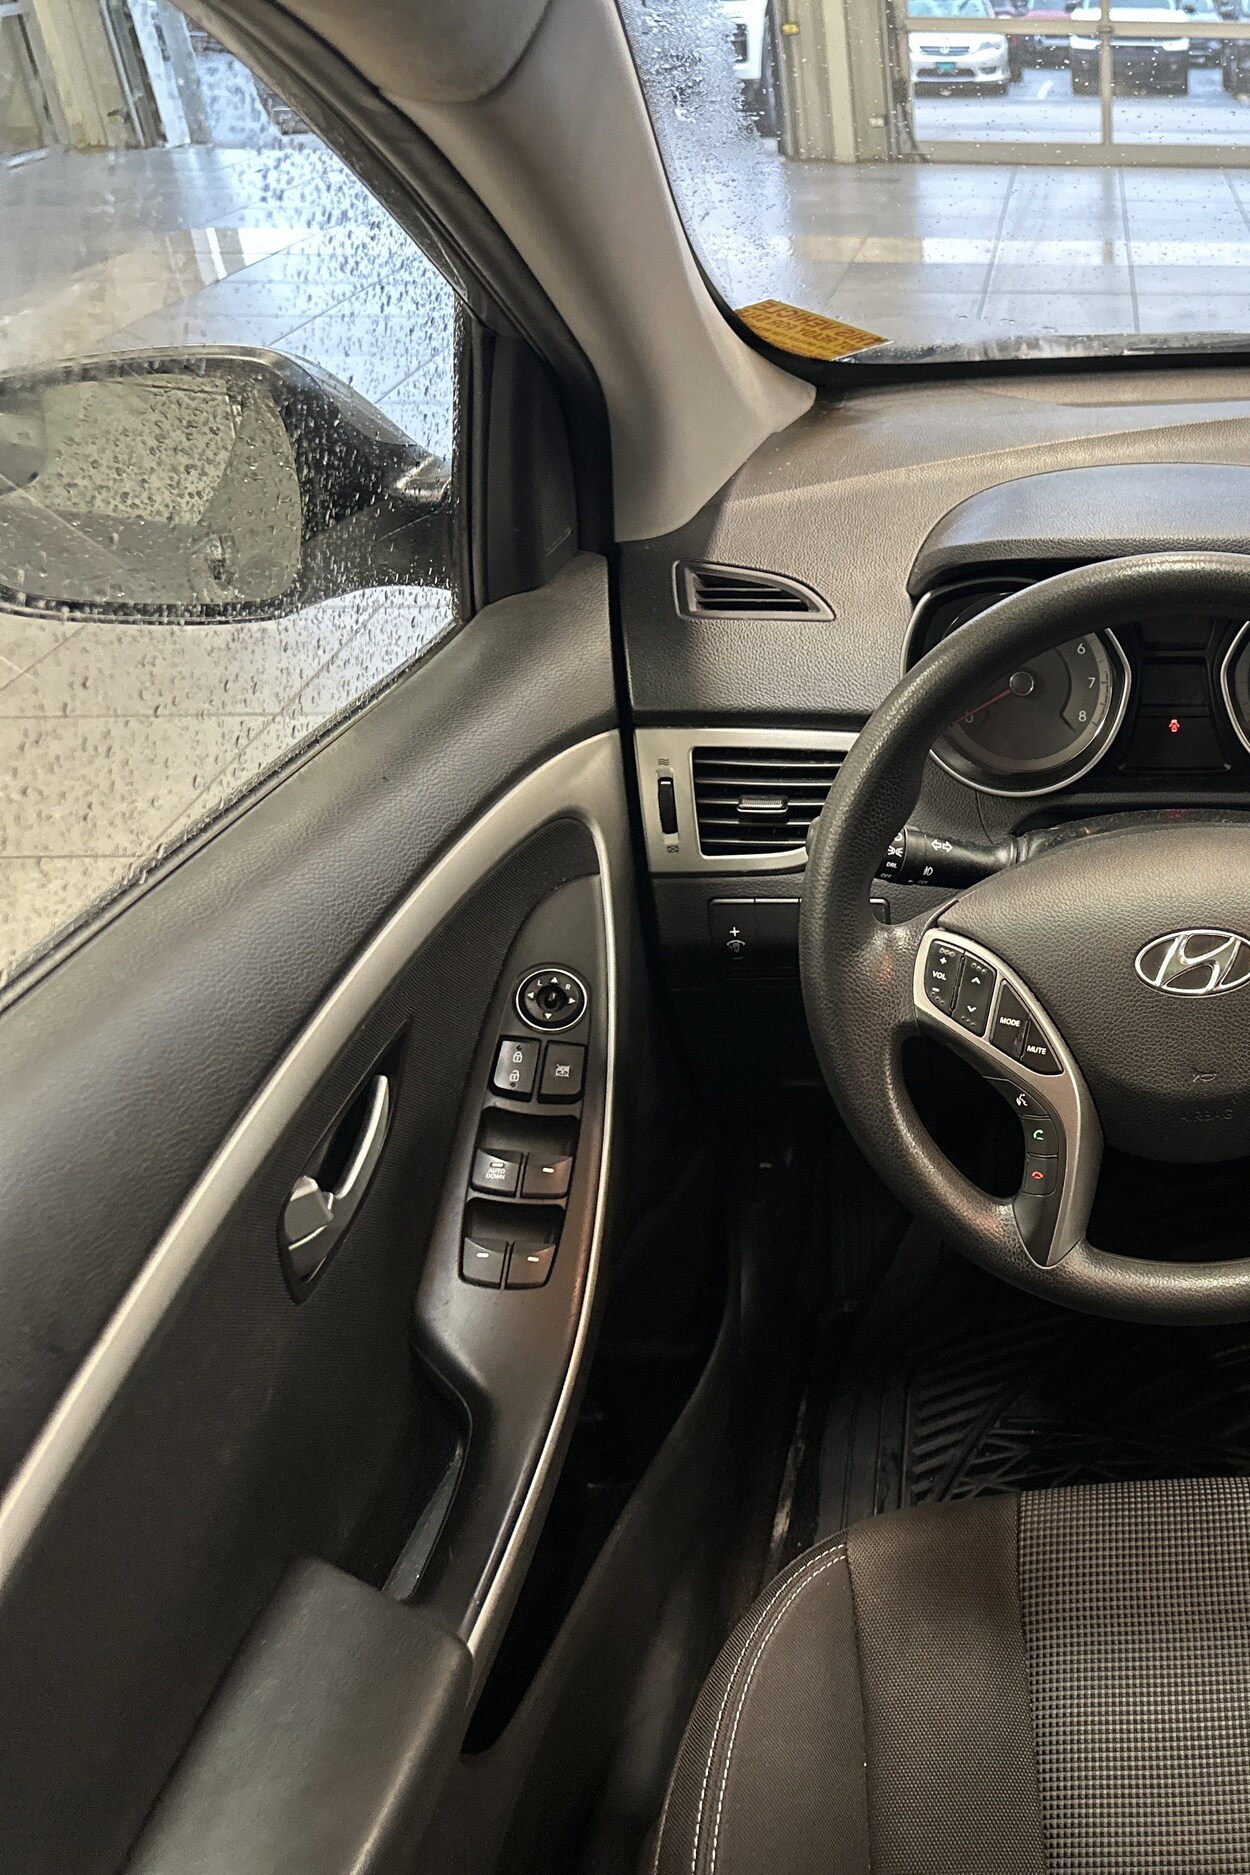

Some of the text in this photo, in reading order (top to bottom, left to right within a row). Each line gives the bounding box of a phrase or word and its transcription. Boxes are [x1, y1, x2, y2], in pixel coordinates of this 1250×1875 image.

[1077, 642, 1086, 655] 6
[1087, 676, 1096, 689] 7
[1078, 710, 1087, 722] 8
[886, 861, 898, 869] DRL
[932, 970, 947, 980] VOL
[1000, 1016, 1021, 1027] MODE
[1027, 1045, 1047, 1055] MUTE
